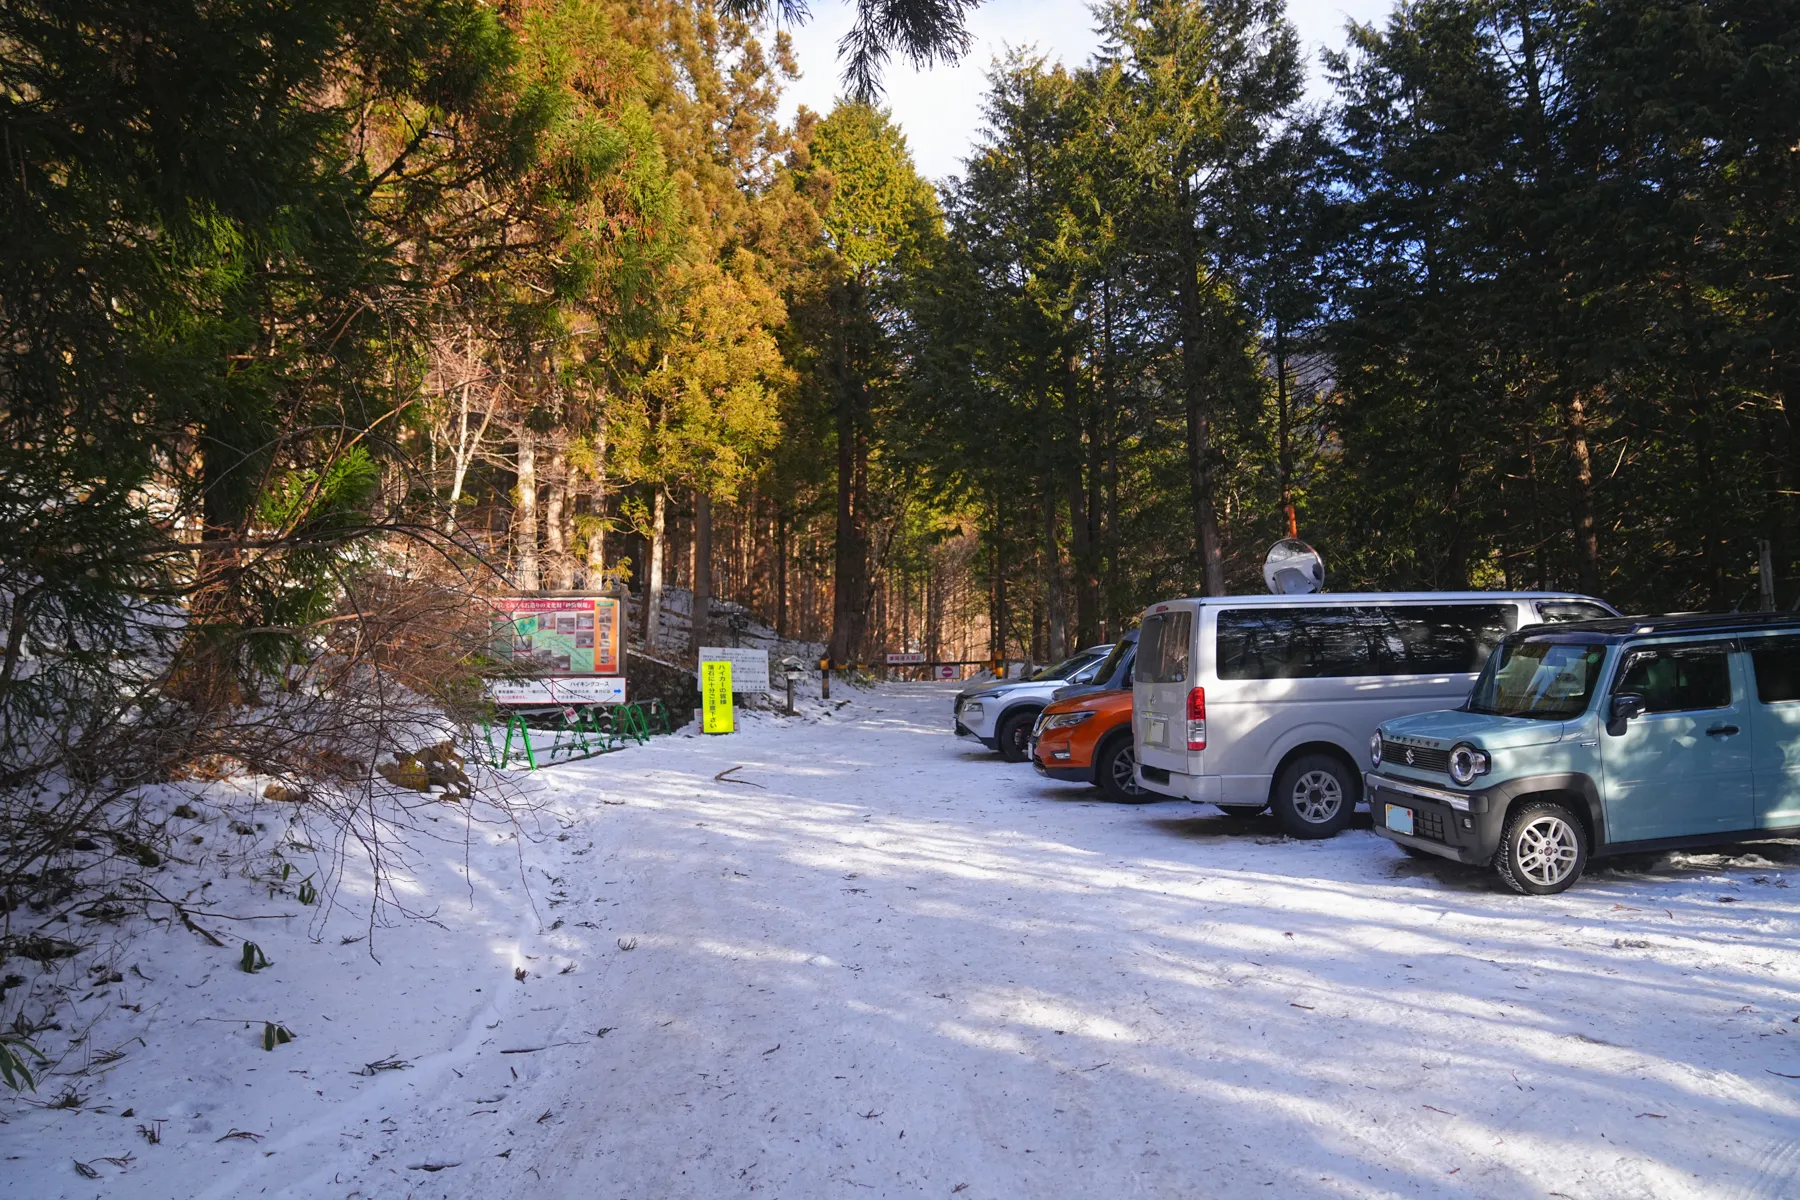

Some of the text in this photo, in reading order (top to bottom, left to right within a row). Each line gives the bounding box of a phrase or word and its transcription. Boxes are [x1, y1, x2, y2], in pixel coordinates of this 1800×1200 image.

[708, 664, 717, 729] 落石に十分ご注意下さい
[718, 664, 727, 705] ハイカーの皆様
